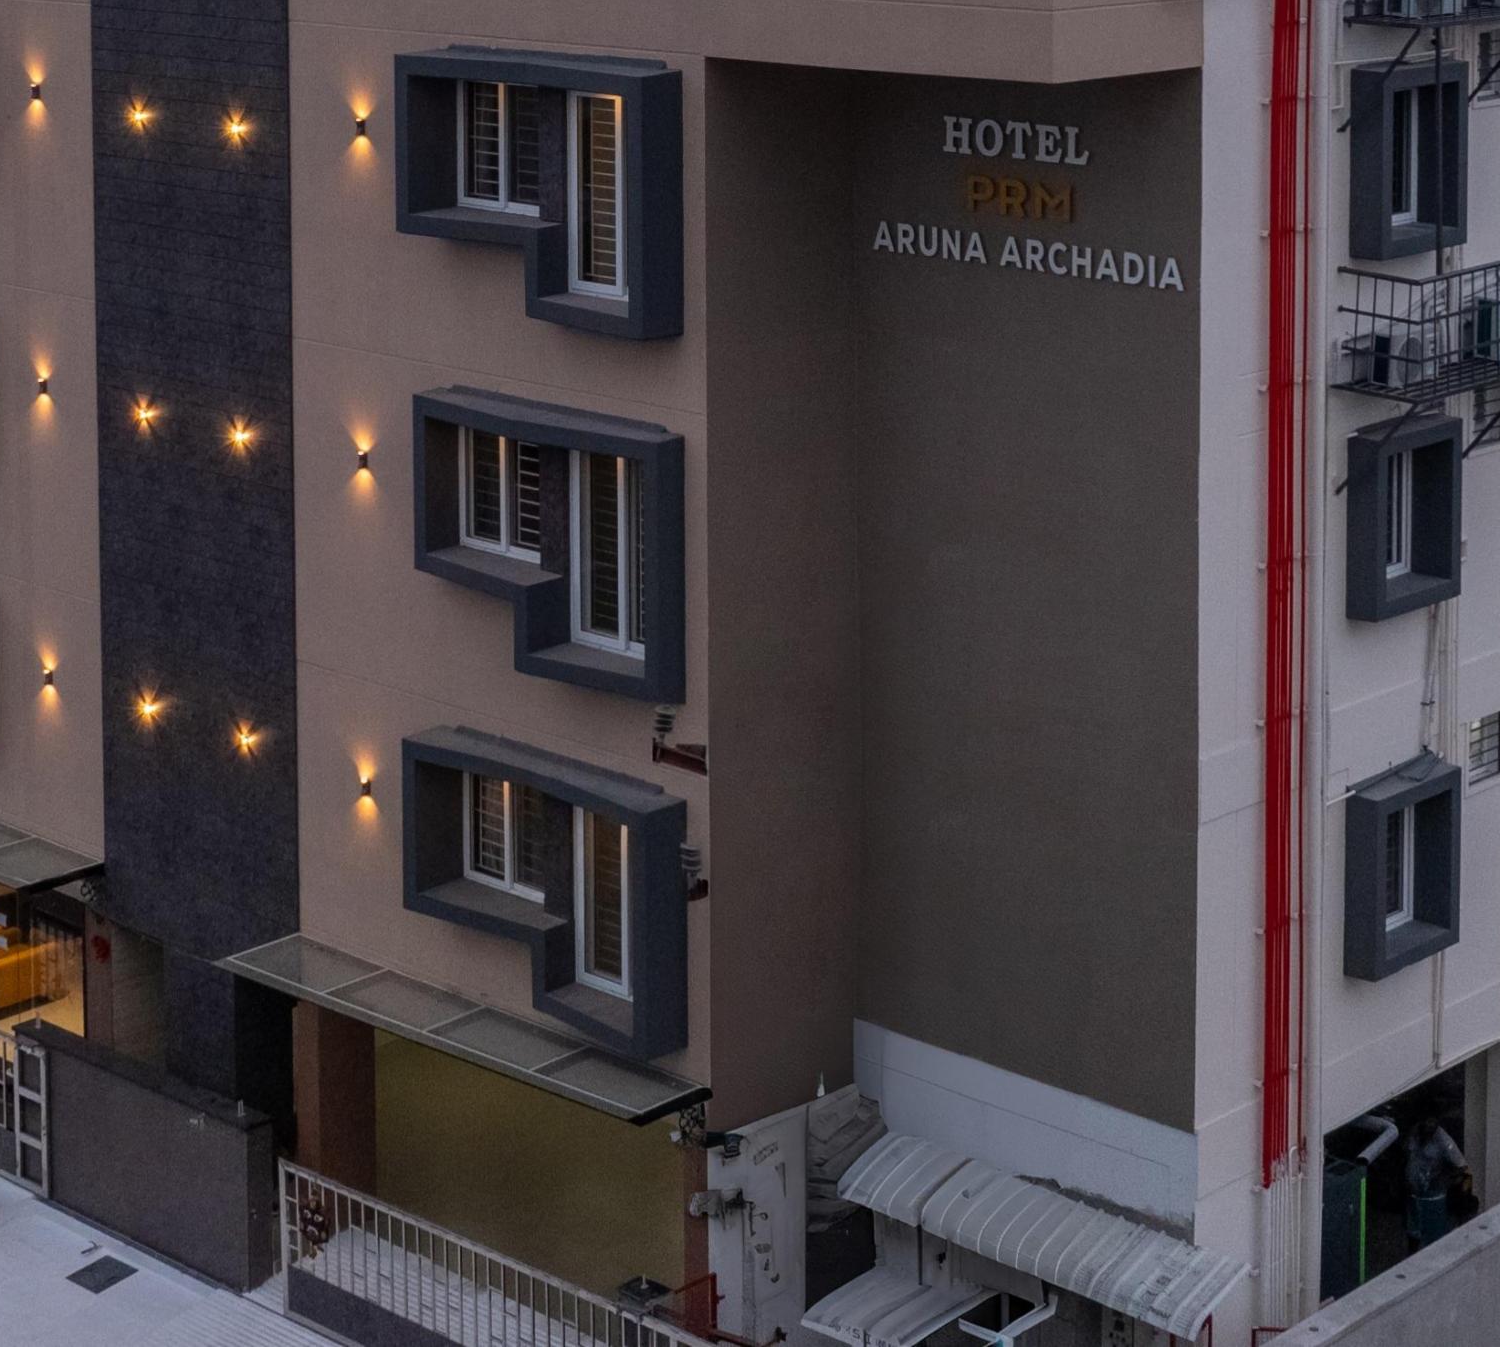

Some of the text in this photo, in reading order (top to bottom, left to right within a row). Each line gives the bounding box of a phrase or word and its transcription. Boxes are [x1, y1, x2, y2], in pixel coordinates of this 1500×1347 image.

[942, 115, 1089, 166] HOTEL
[966, 173, 1074, 222] PRM
[872, 221, 1185, 292] ARUNA ARCHADIA
